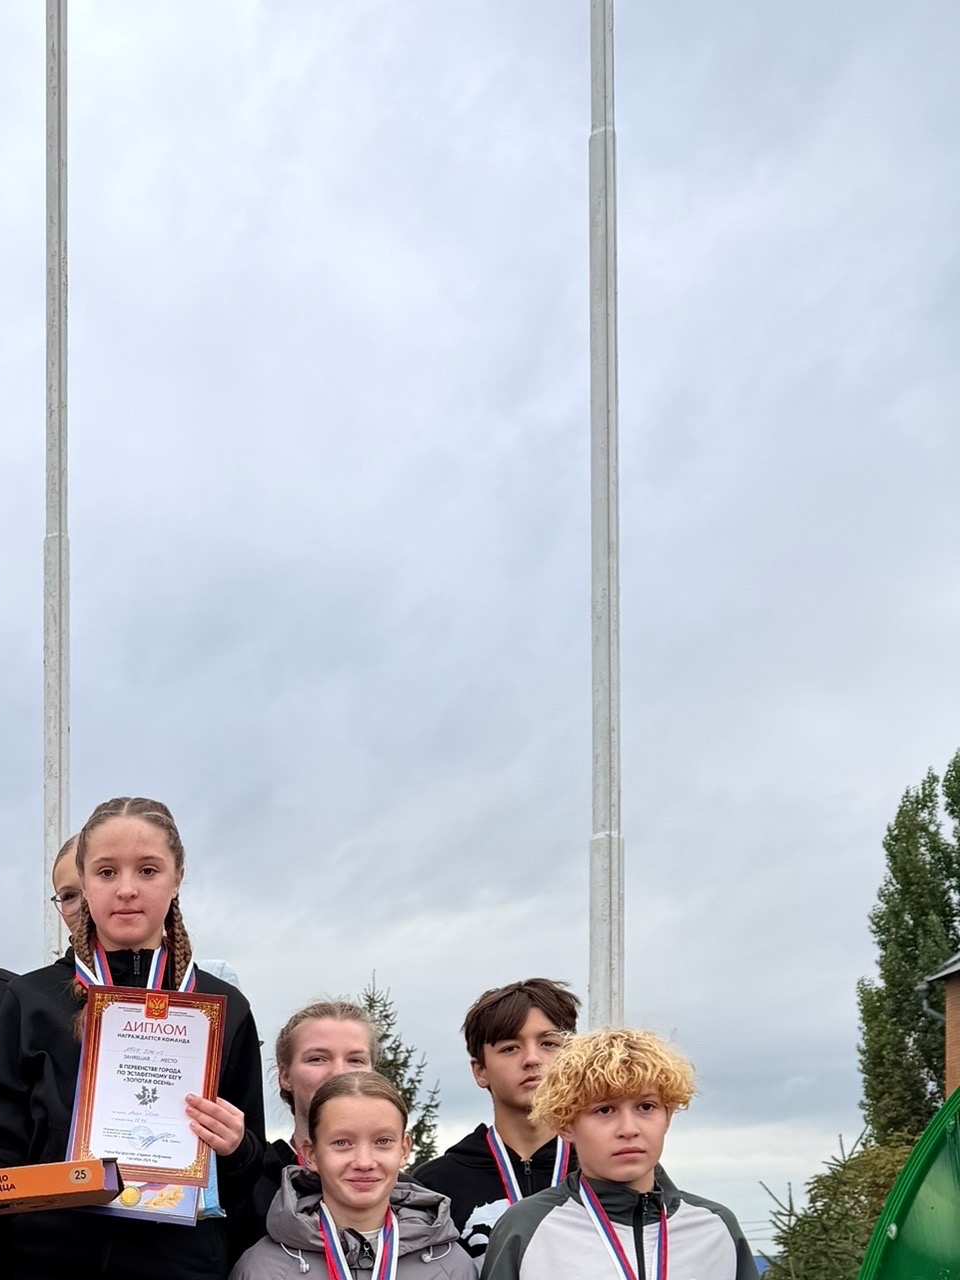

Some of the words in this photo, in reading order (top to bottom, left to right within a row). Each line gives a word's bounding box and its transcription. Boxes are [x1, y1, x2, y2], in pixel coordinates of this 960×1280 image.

[123, 1021, 187, 1036] ДИПЛОМ
[117, 1033, 161, 1042] НАГРАЖДАЕТСЯ
[162, 1036, 190, 1044] КОМАНДА
[124, 1054, 150, 1062] ЗАНЯВШАЯ
[124, 1064, 158, 1072] ПЕРВЕНСТВЕ
[126, 1070, 168, 1080] ЭСТАФЕТНОМУ
[74, 1170, 86, 1180] 25
